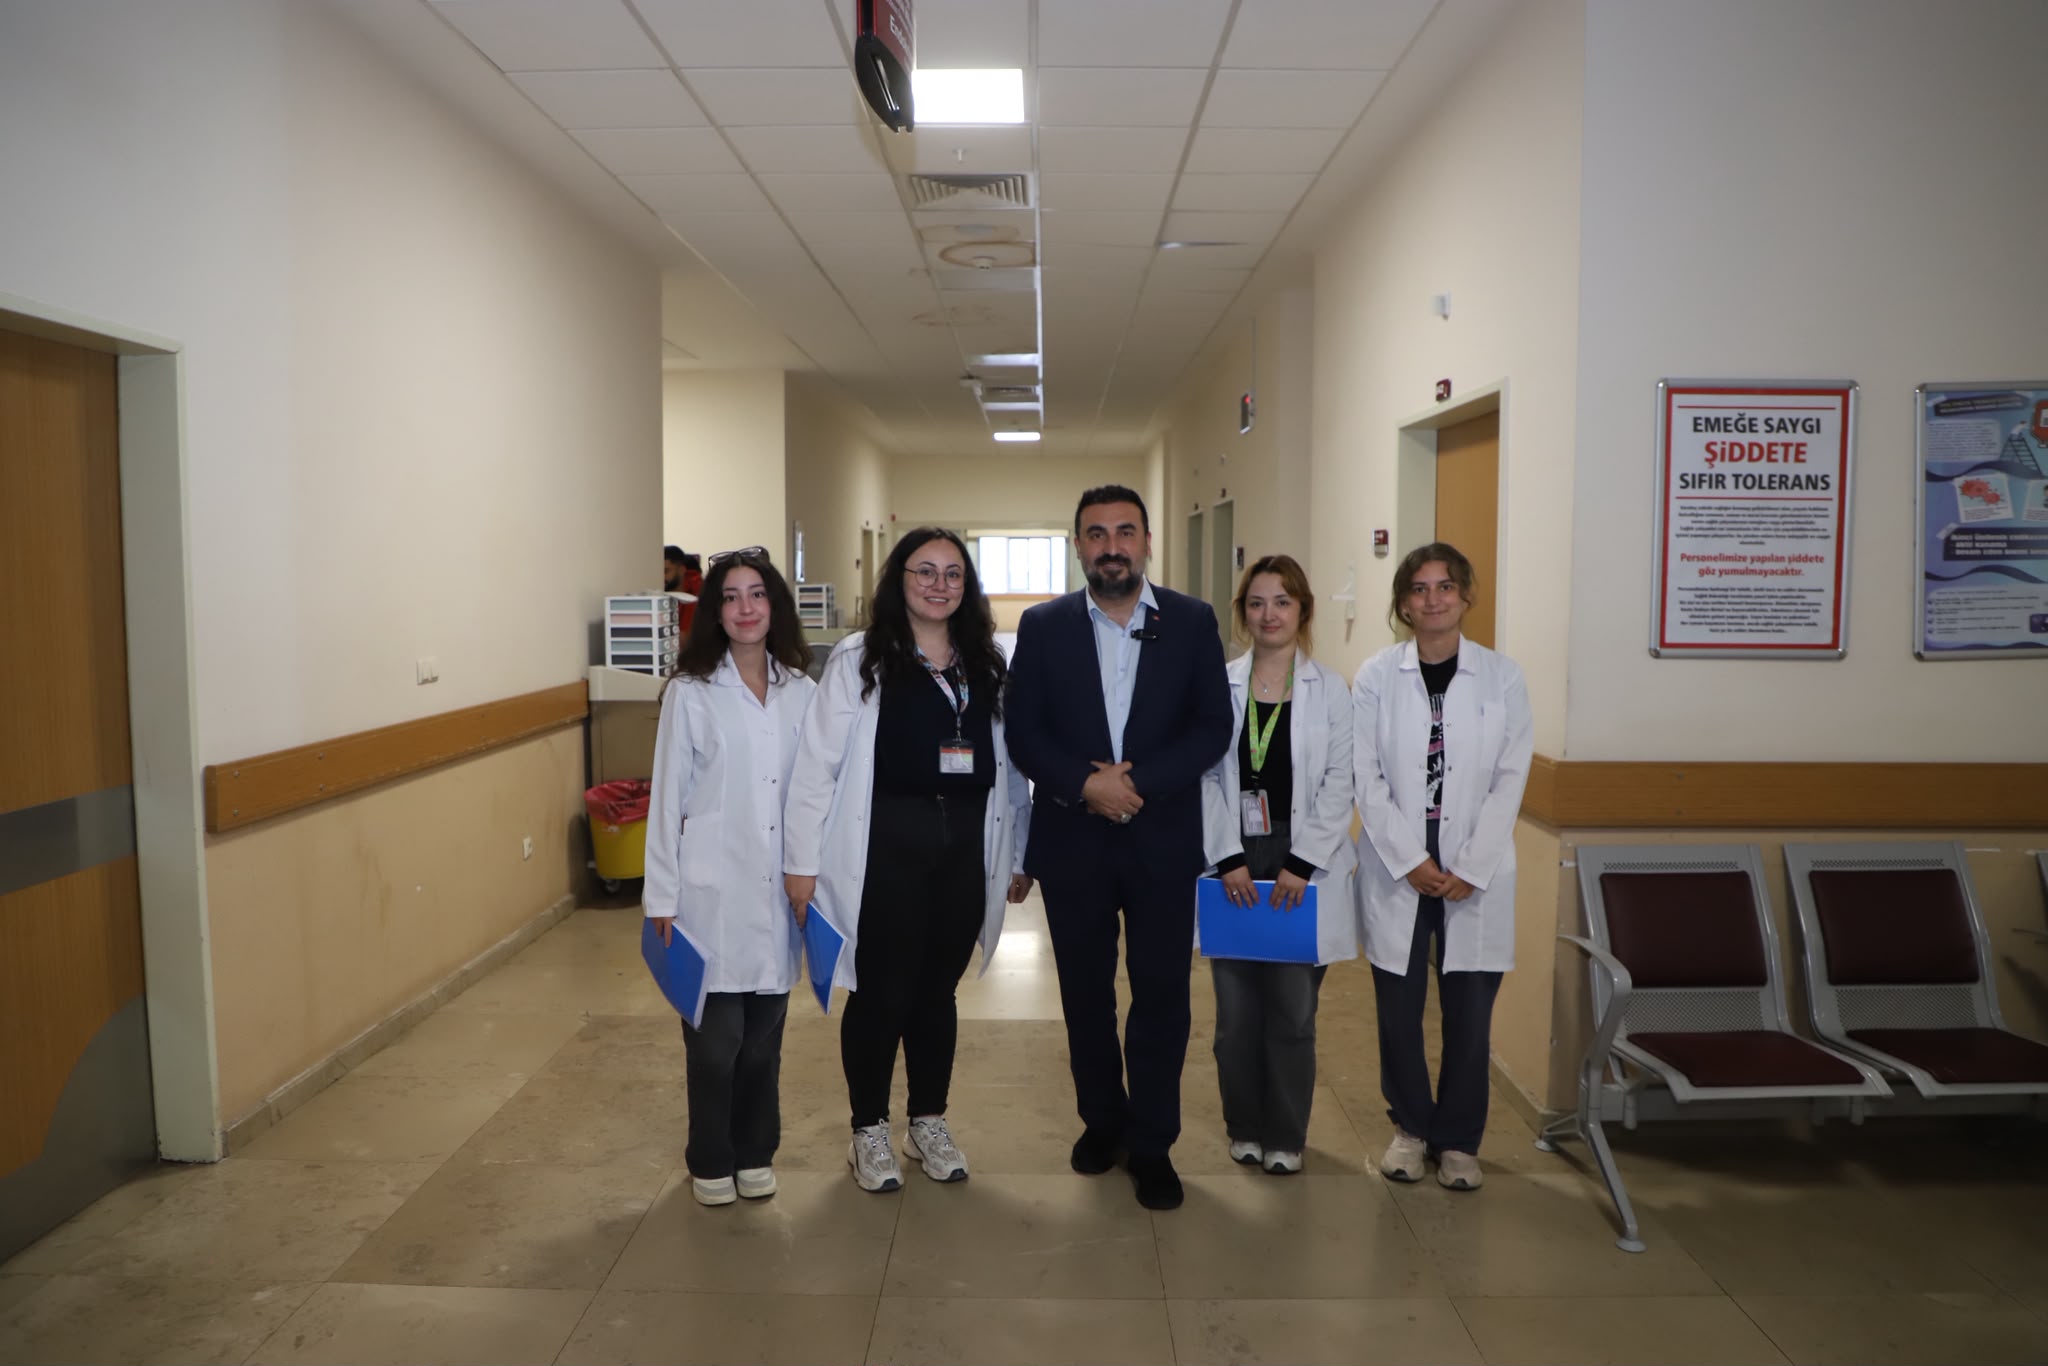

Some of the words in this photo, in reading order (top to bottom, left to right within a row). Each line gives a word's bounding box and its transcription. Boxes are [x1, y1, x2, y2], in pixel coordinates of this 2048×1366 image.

[1692, 412, 1759, 434] EMEĞE
[1763, 417, 1821, 434] SAYGI
[1679, 472, 1727, 490] SIFIR
[1731, 473, 1831, 491] TOLERANS
[1680, 553, 1748, 563] Personelimize
[1750, 554, 1786, 565] yapılan
[1787, 554, 1825, 565] şiddete
[1698, 566, 1716, 577] göz
